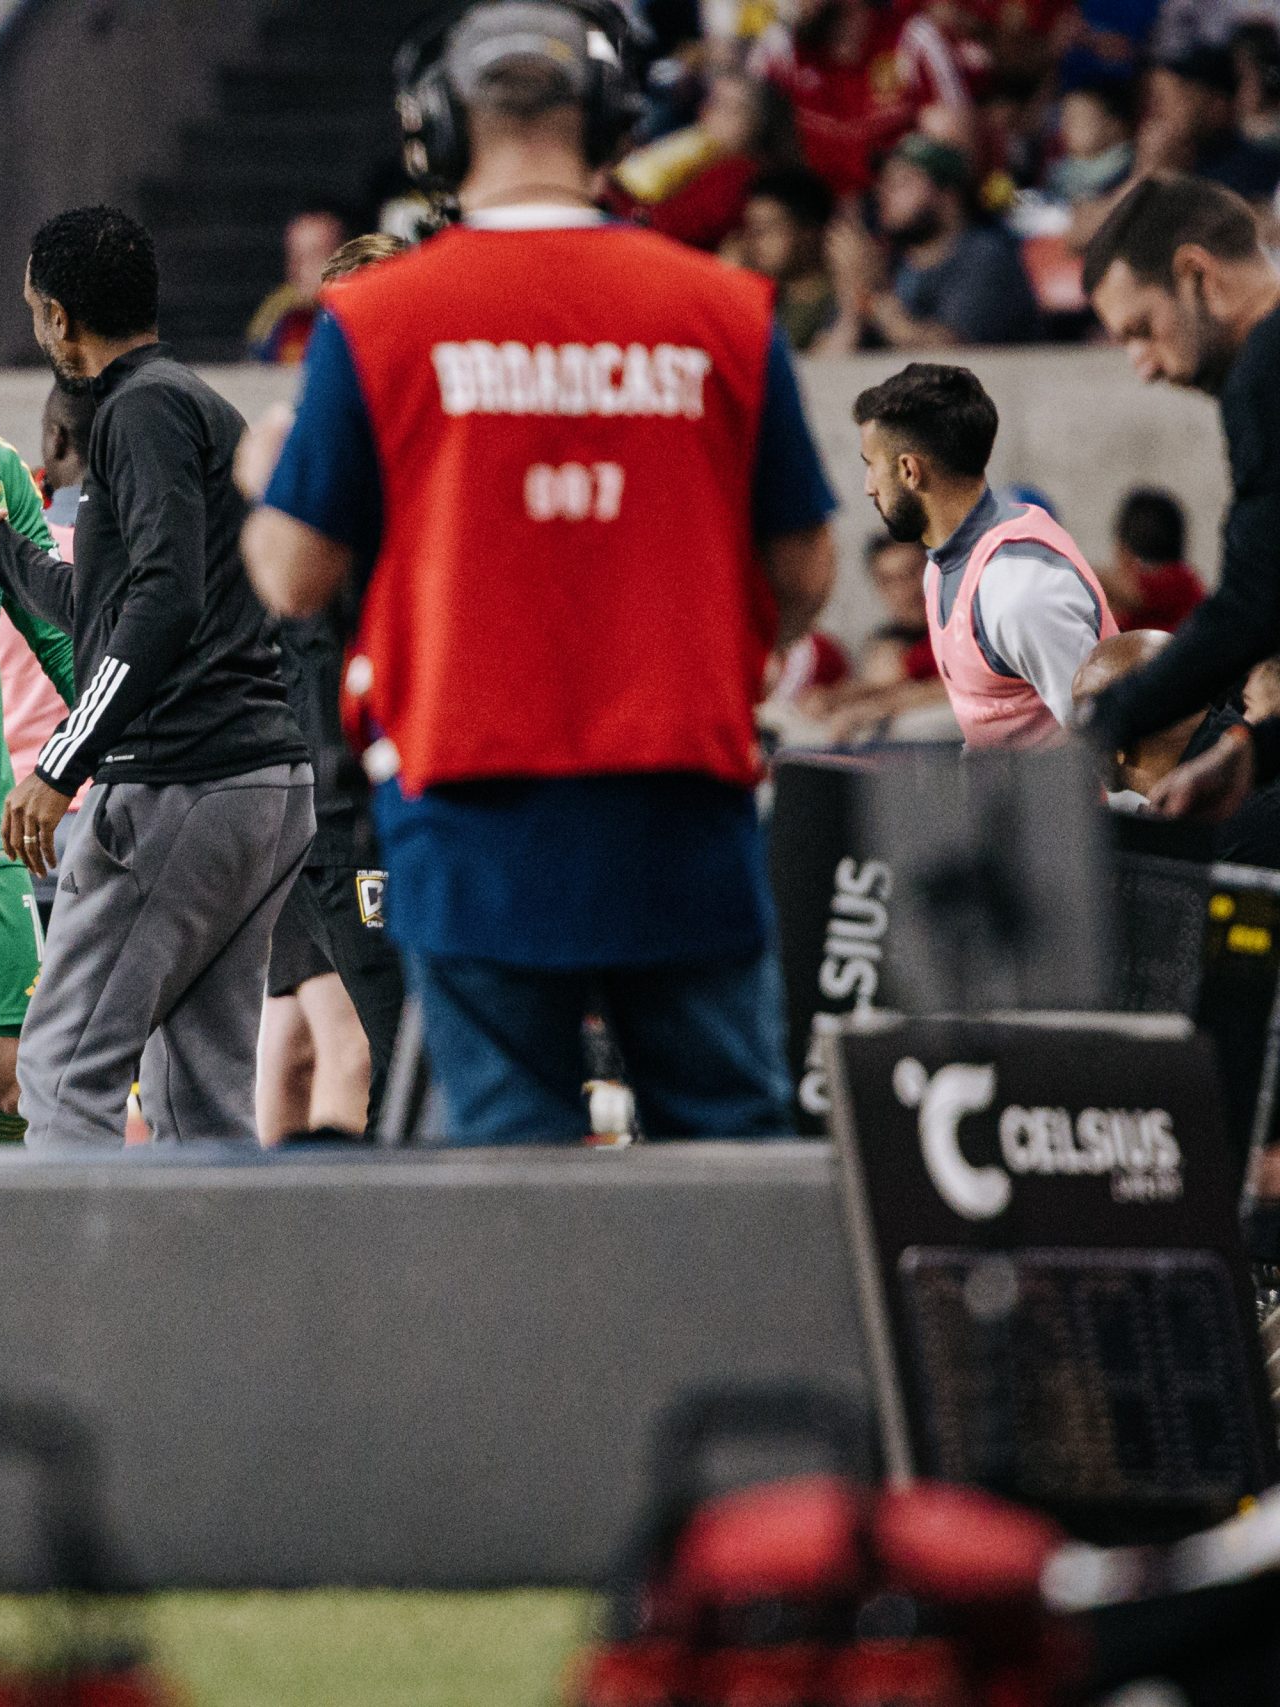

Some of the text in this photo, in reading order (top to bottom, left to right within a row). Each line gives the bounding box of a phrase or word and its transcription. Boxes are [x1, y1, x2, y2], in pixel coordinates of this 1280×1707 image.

[430, 340, 713, 420] BROADCAST
[798, 856, 893, 1115] CLSIUS
[998, 1104, 1181, 1174] CELSIUS
